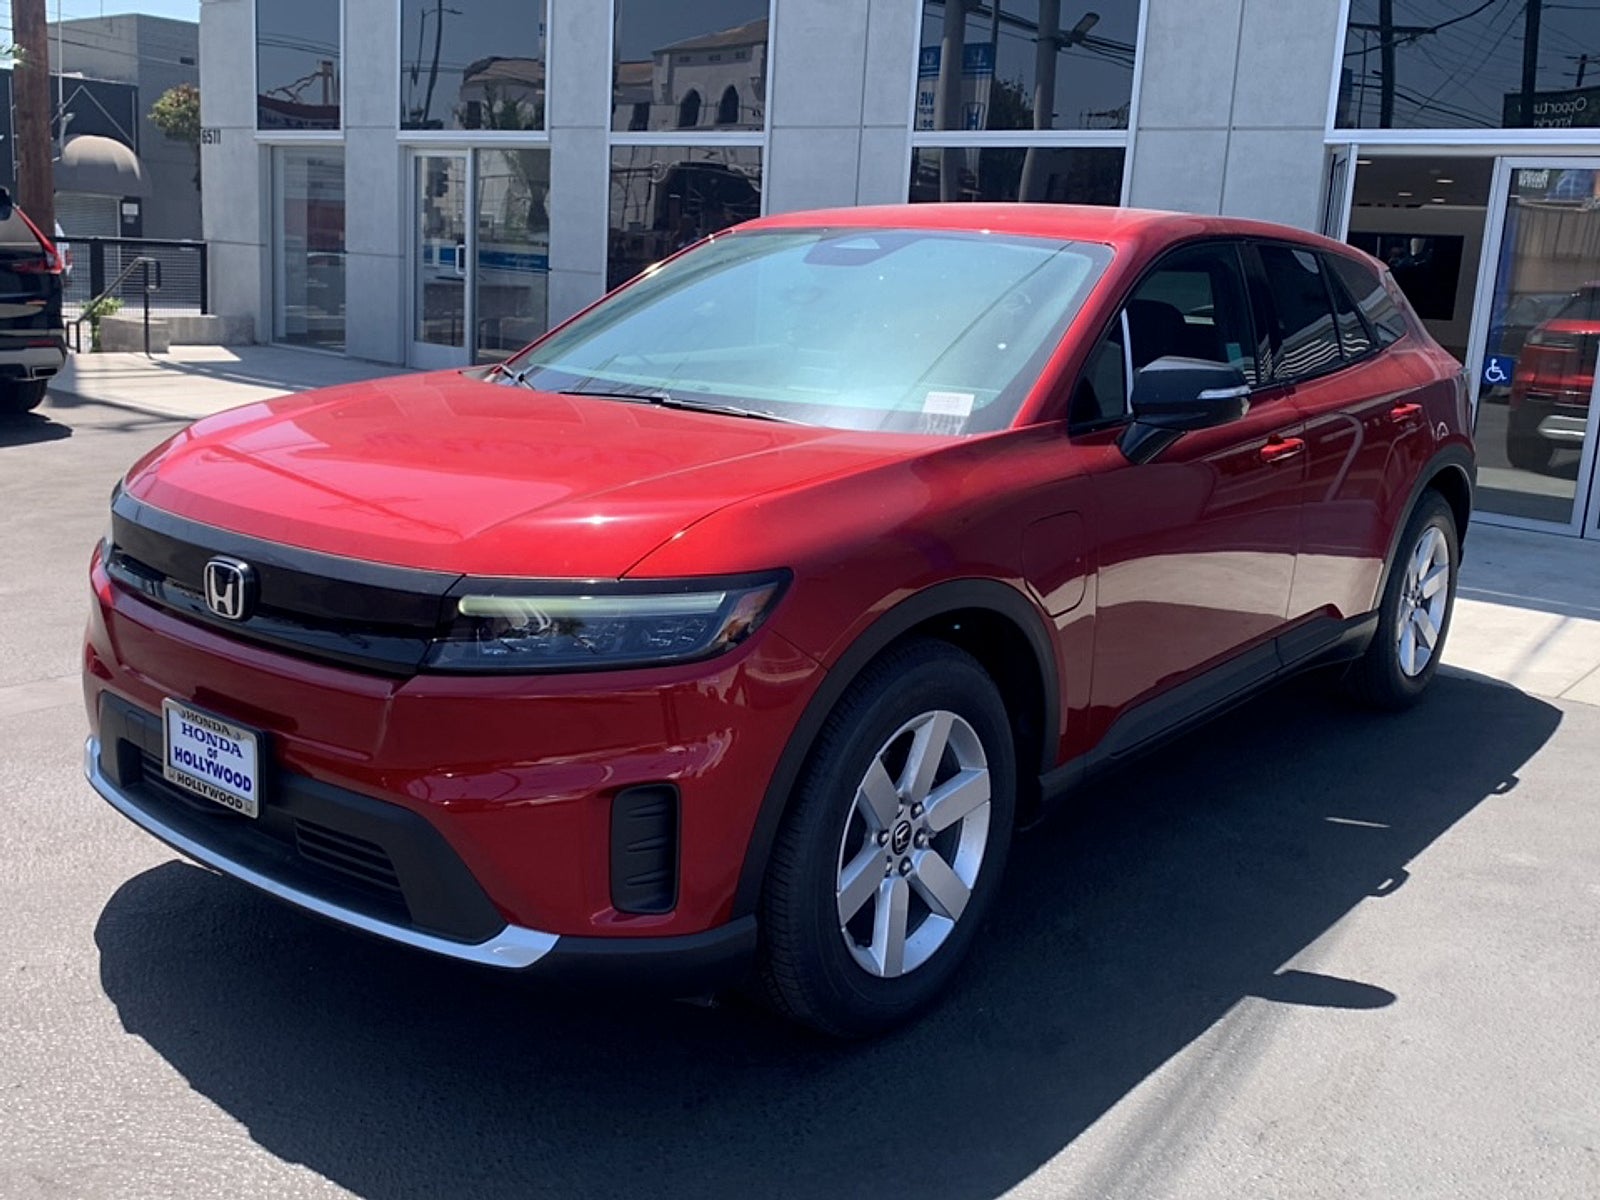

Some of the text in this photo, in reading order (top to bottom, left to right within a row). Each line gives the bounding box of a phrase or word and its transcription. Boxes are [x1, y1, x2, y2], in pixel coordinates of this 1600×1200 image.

[202, 129, 221, 145] 6511
[181, 721, 243, 758] HONDA
[186, 710, 231, 735] HONDA
[174, 746, 252, 792] HOLLYWOOD
[176, 773, 243, 810] HOLLYWOOD
